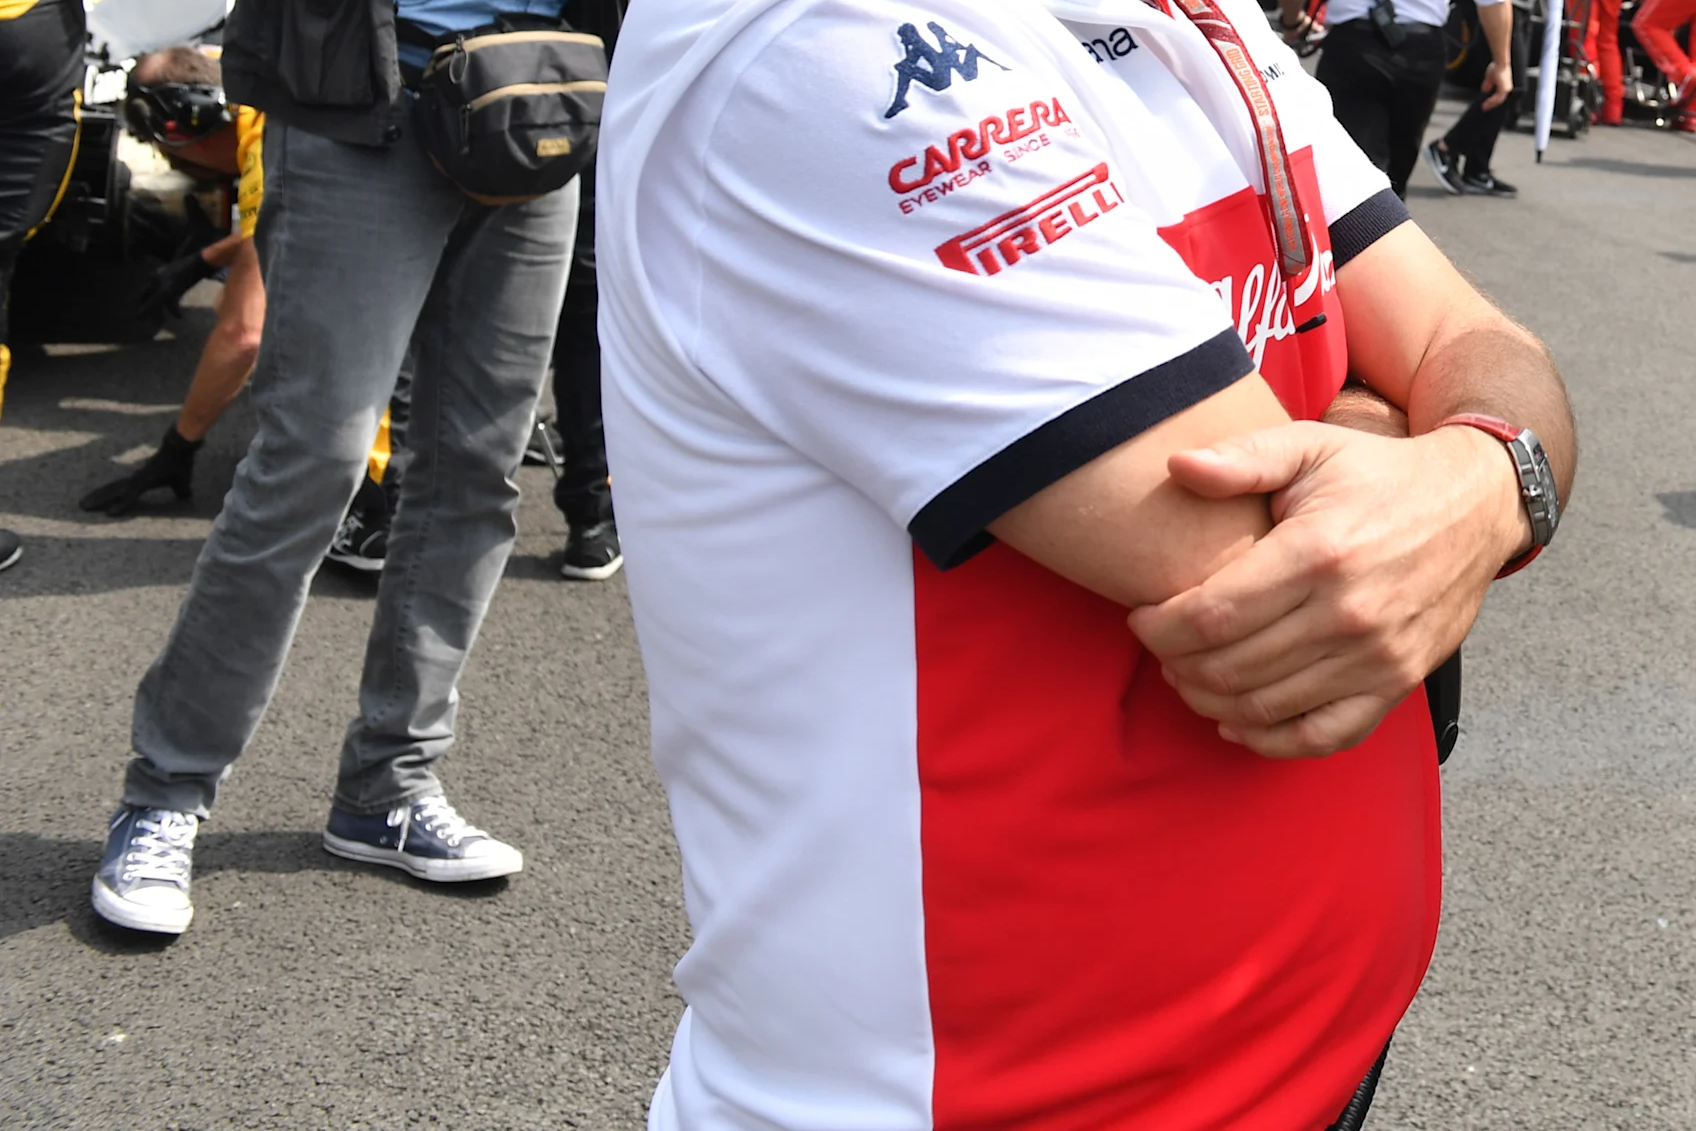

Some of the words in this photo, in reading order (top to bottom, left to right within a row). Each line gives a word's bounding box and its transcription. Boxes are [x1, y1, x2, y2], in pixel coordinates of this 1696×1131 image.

[1225, 45, 1248, 72] GRID
[1238, 68, 1270, 118] STARTING
[888, 96, 1072, 195] CARRERA
[898, 160, 992, 215] EYEWEAR
[1003, 133, 1051, 163] SINCE
[933, 161, 1126, 277] PIRELLI
